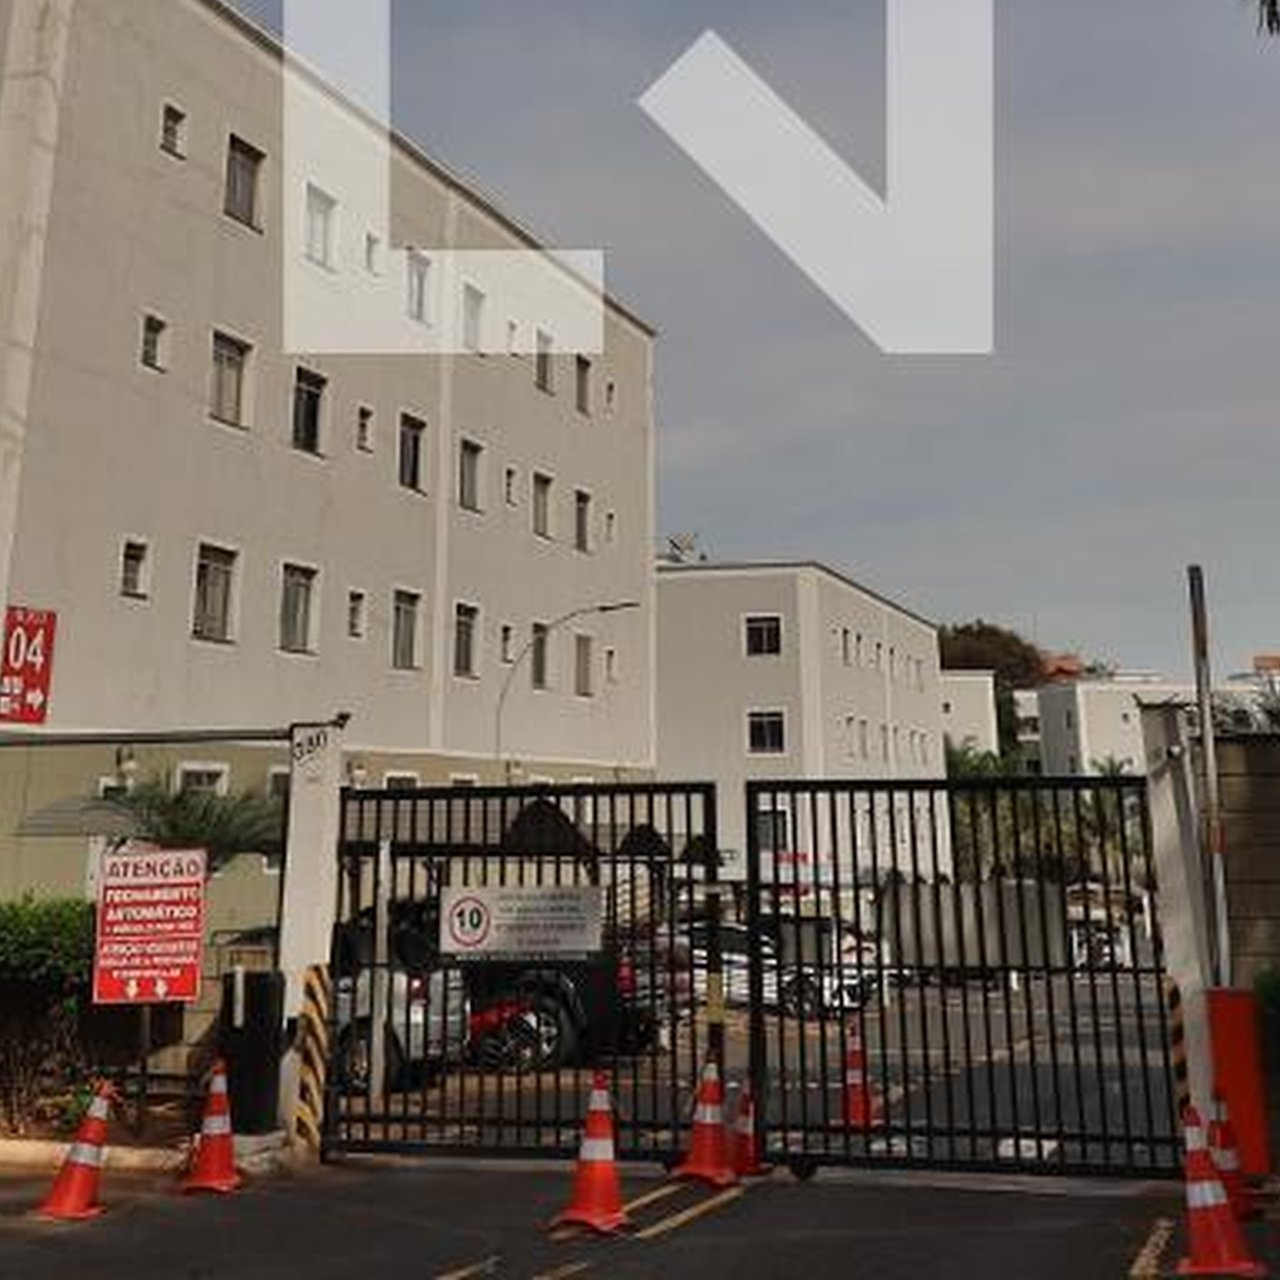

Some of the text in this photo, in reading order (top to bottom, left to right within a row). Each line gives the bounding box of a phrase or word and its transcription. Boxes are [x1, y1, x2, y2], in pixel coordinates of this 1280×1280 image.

[8, 625, 45, 672] 04
[109, 857, 200, 879] ATENÇÃO
[106, 887, 200, 903] FECHAMENTO
[106, 903, 198, 920] AUTOMÁTICO
[457, 907, 482, 930] 10
